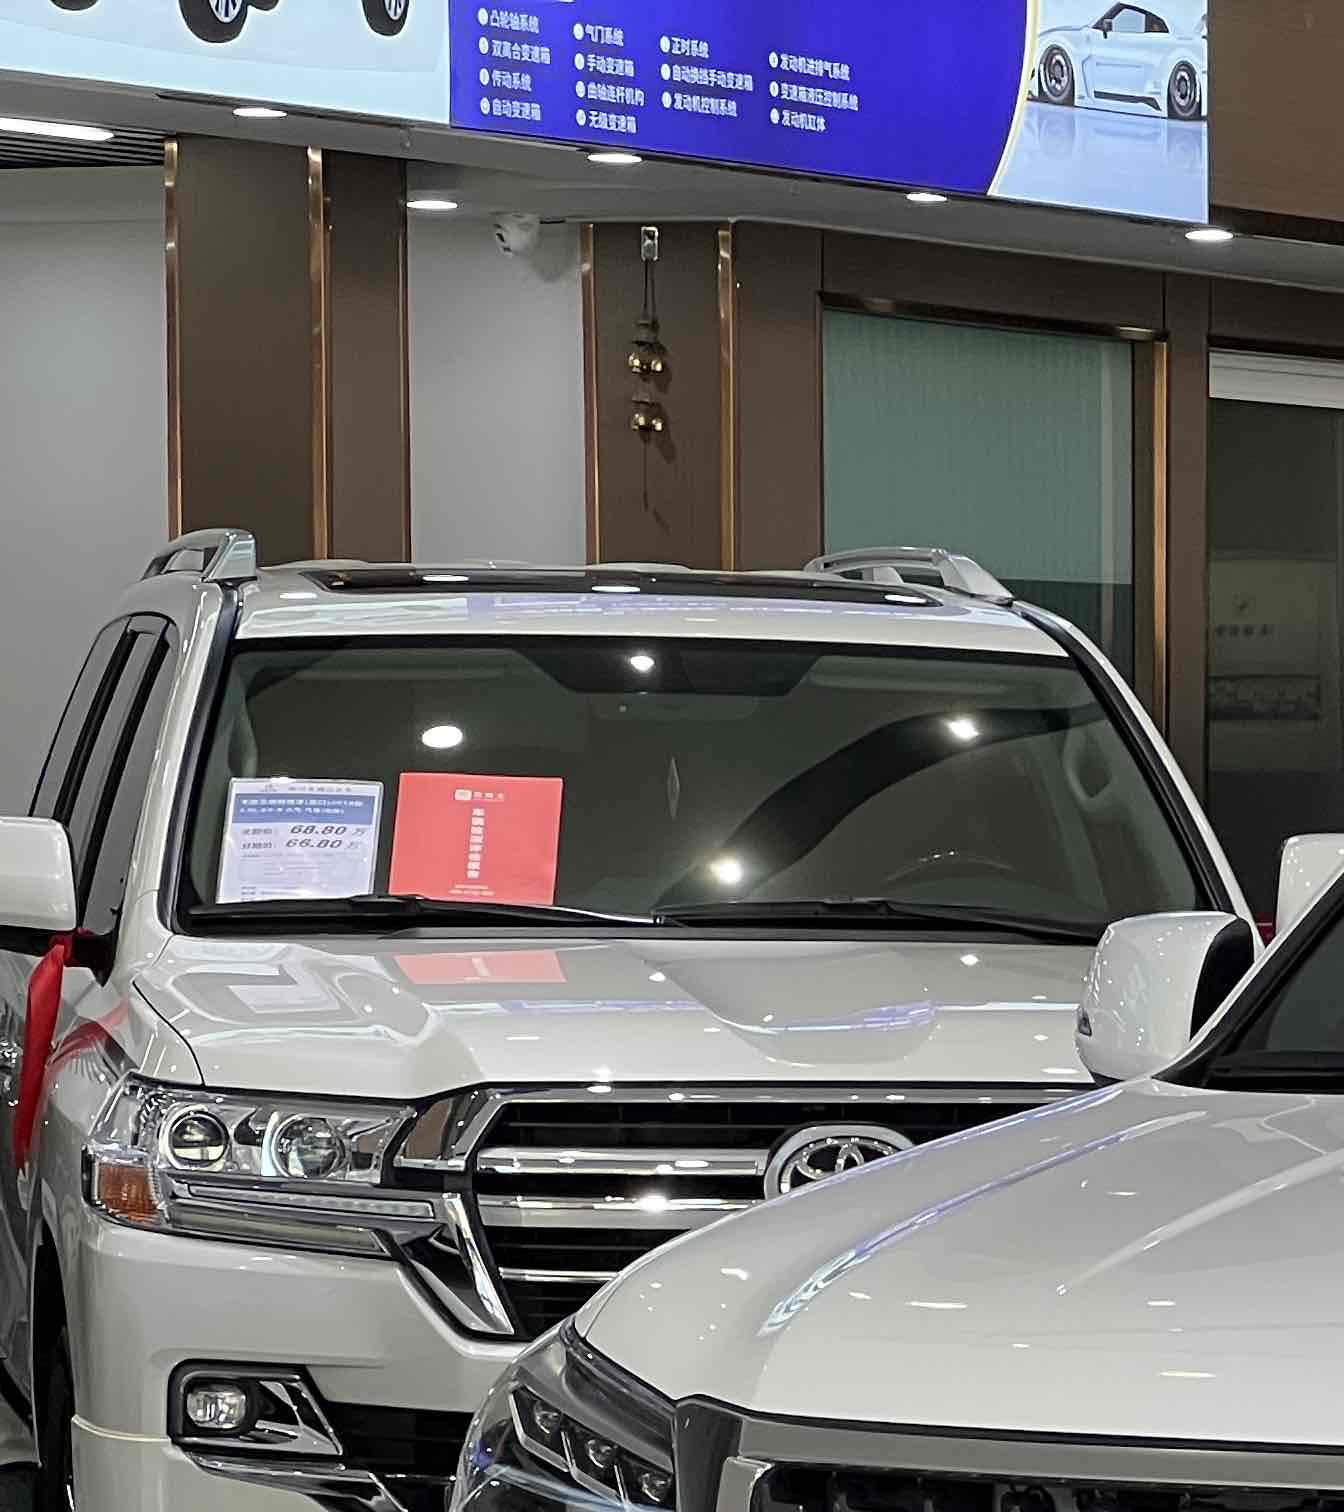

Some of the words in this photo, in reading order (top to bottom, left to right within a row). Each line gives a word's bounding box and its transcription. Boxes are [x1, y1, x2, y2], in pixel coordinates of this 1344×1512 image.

[585, 23, 624, 46] 气门系统
[491, 39, 551, 65] 双离合变速箱
[671, 36, 709, 58] 正时系统
[587, 54, 634, 77] 手动变速箱
[491, 69, 532, 92] 传动系统
[492, 98, 541, 121] 自动变速箱
